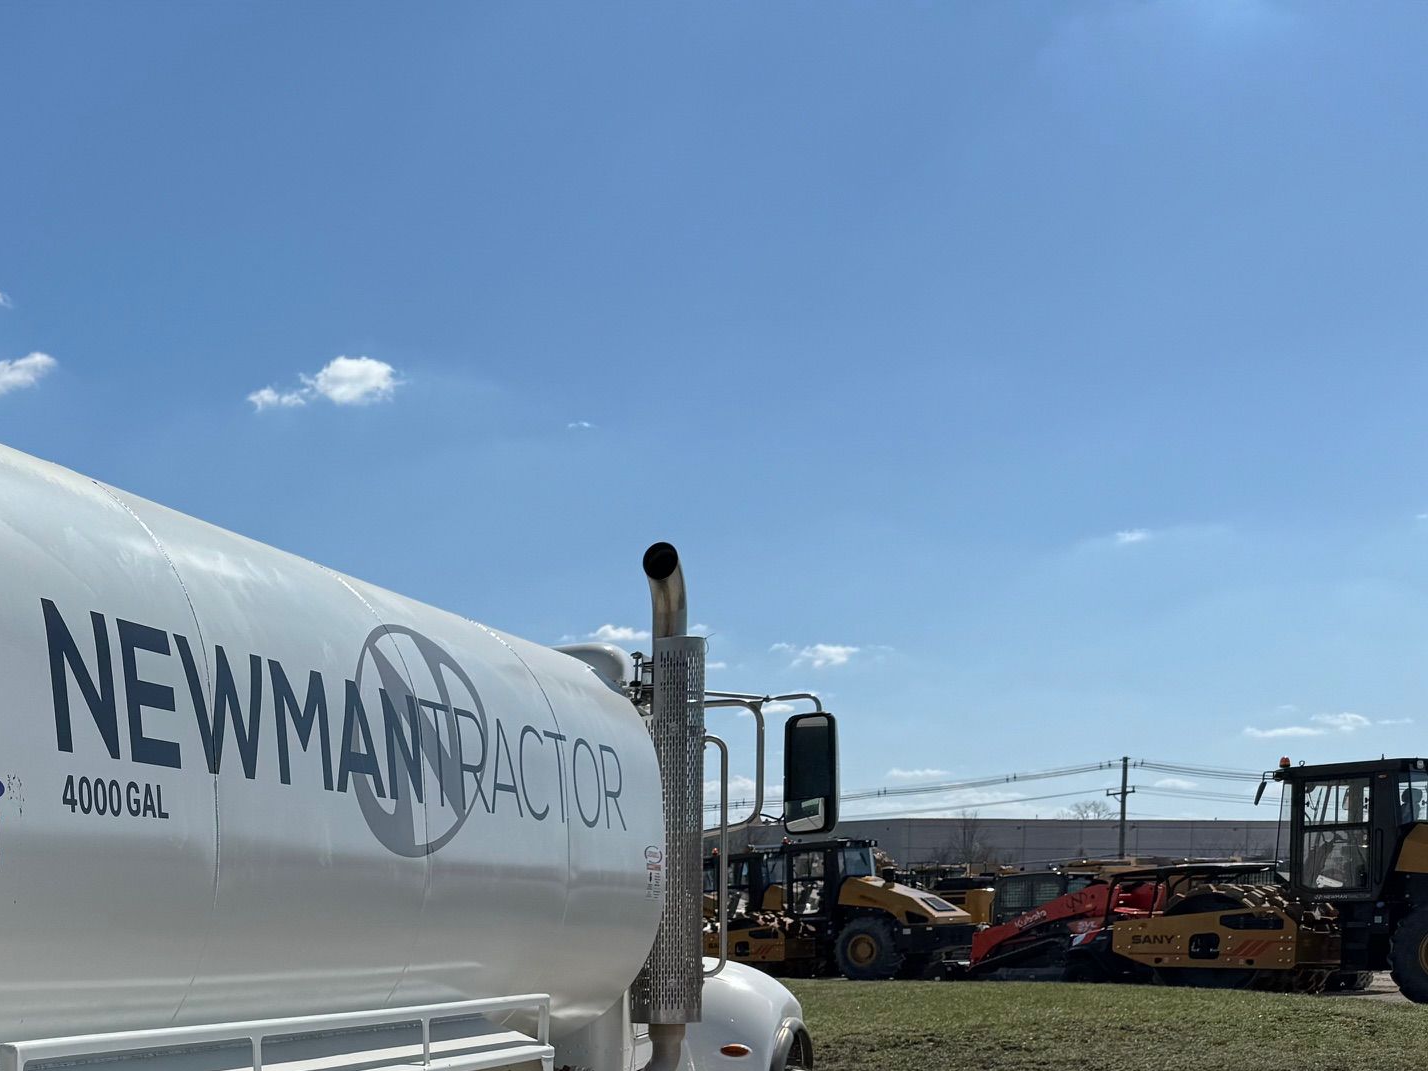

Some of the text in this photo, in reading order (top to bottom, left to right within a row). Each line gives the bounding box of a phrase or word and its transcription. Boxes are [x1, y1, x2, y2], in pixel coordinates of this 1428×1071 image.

[62, 774, 170, 819] 4000 GAL
[1132, 935, 1174, 944] SANY
